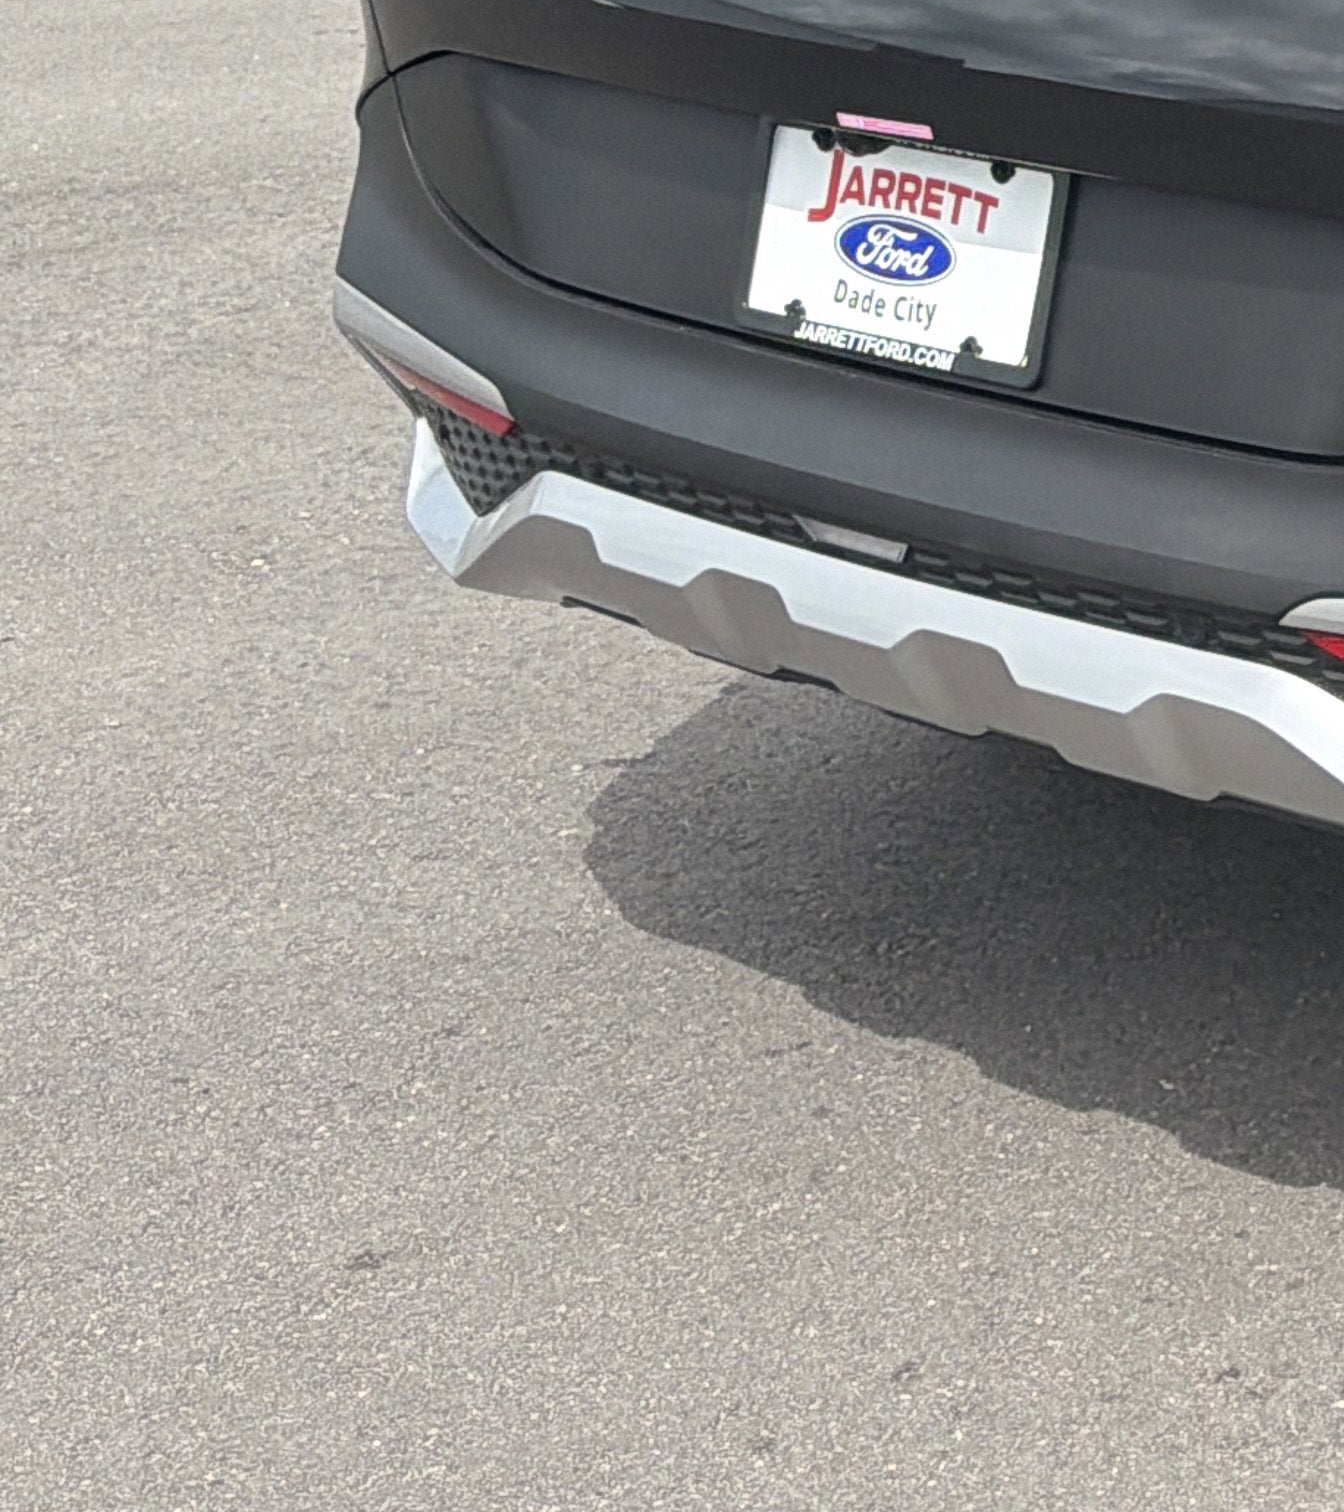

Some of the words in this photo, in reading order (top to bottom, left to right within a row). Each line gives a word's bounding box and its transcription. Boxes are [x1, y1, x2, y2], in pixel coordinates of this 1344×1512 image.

[808, 149, 999, 234] JARRETT
[855, 223, 935, 278] Ford
[833, 279, 887, 318] Dade
[893, 295, 938, 332] City
[794, 321, 955, 371] JARRETTFORD.COM
